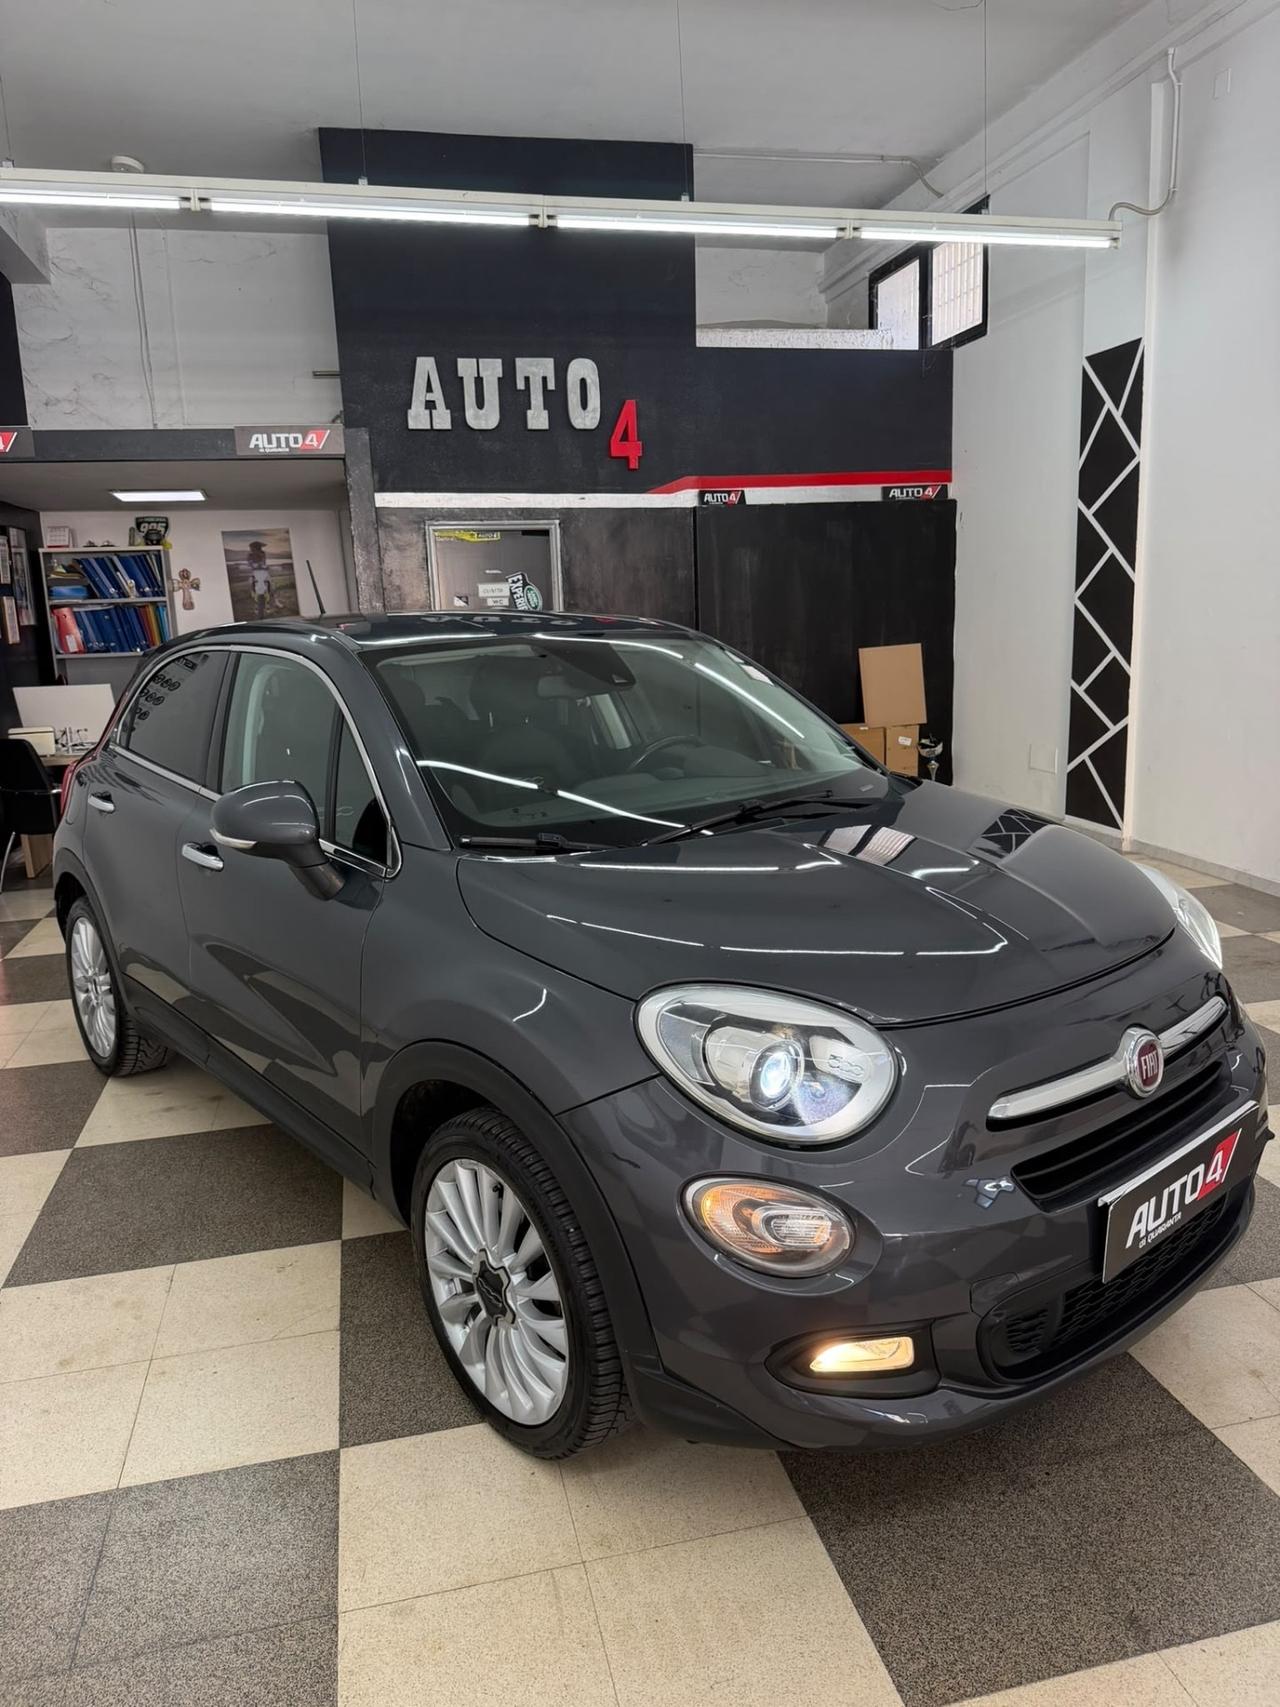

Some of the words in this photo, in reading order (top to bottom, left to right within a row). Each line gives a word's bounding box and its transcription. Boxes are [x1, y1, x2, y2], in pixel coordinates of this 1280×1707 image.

[407, 356, 601, 430] AUTO
[610, 399, 642, 469] 4
[1140, 1050, 1158, 1080] FIAT
[1125, 1149, 1224, 1249] AUTO4
